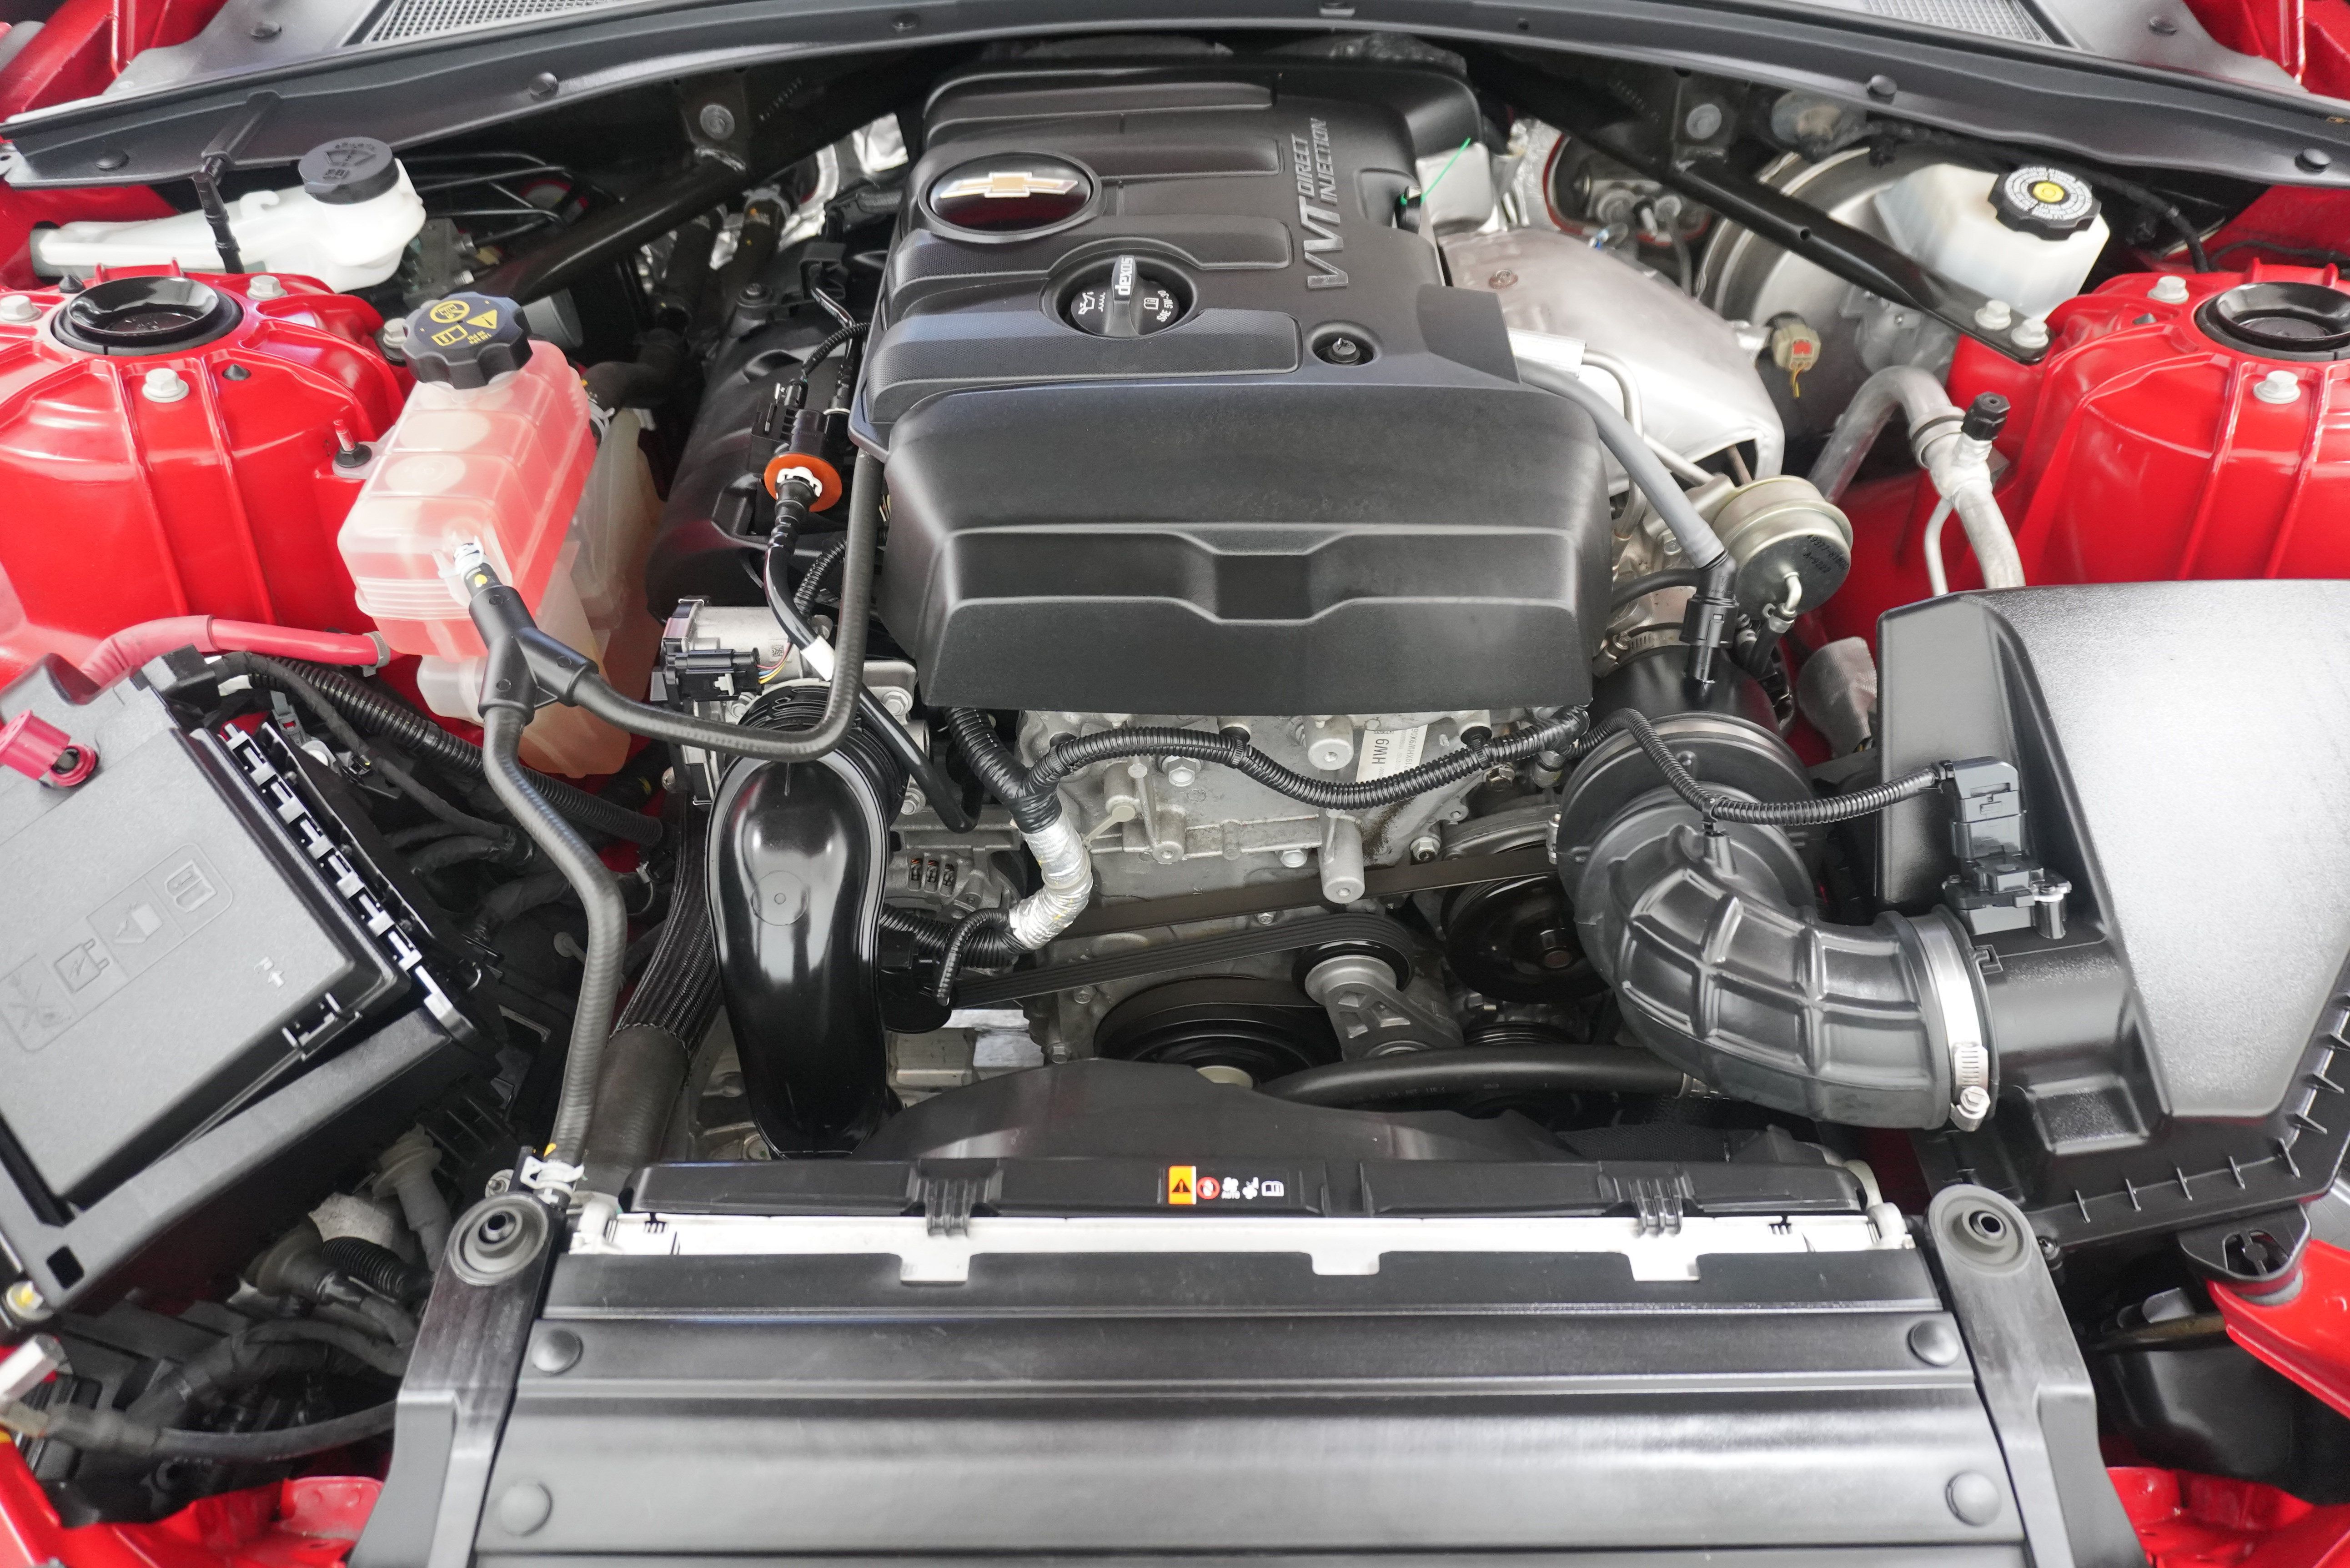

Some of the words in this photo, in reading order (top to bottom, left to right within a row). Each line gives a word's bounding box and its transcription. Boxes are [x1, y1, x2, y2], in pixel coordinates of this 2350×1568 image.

[1291, 134, 1315, 198] DIRECT
[1311, 117, 1337, 205] INJECTION
[1299, 195, 1349, 289] VVT
[1115, 256, 1133, 295] dexos
[1156, 309, 1171, 322] SAE
[1157, 290, 1173, 309] 5W-30
[1371, 739, 1390, 764] HW9
